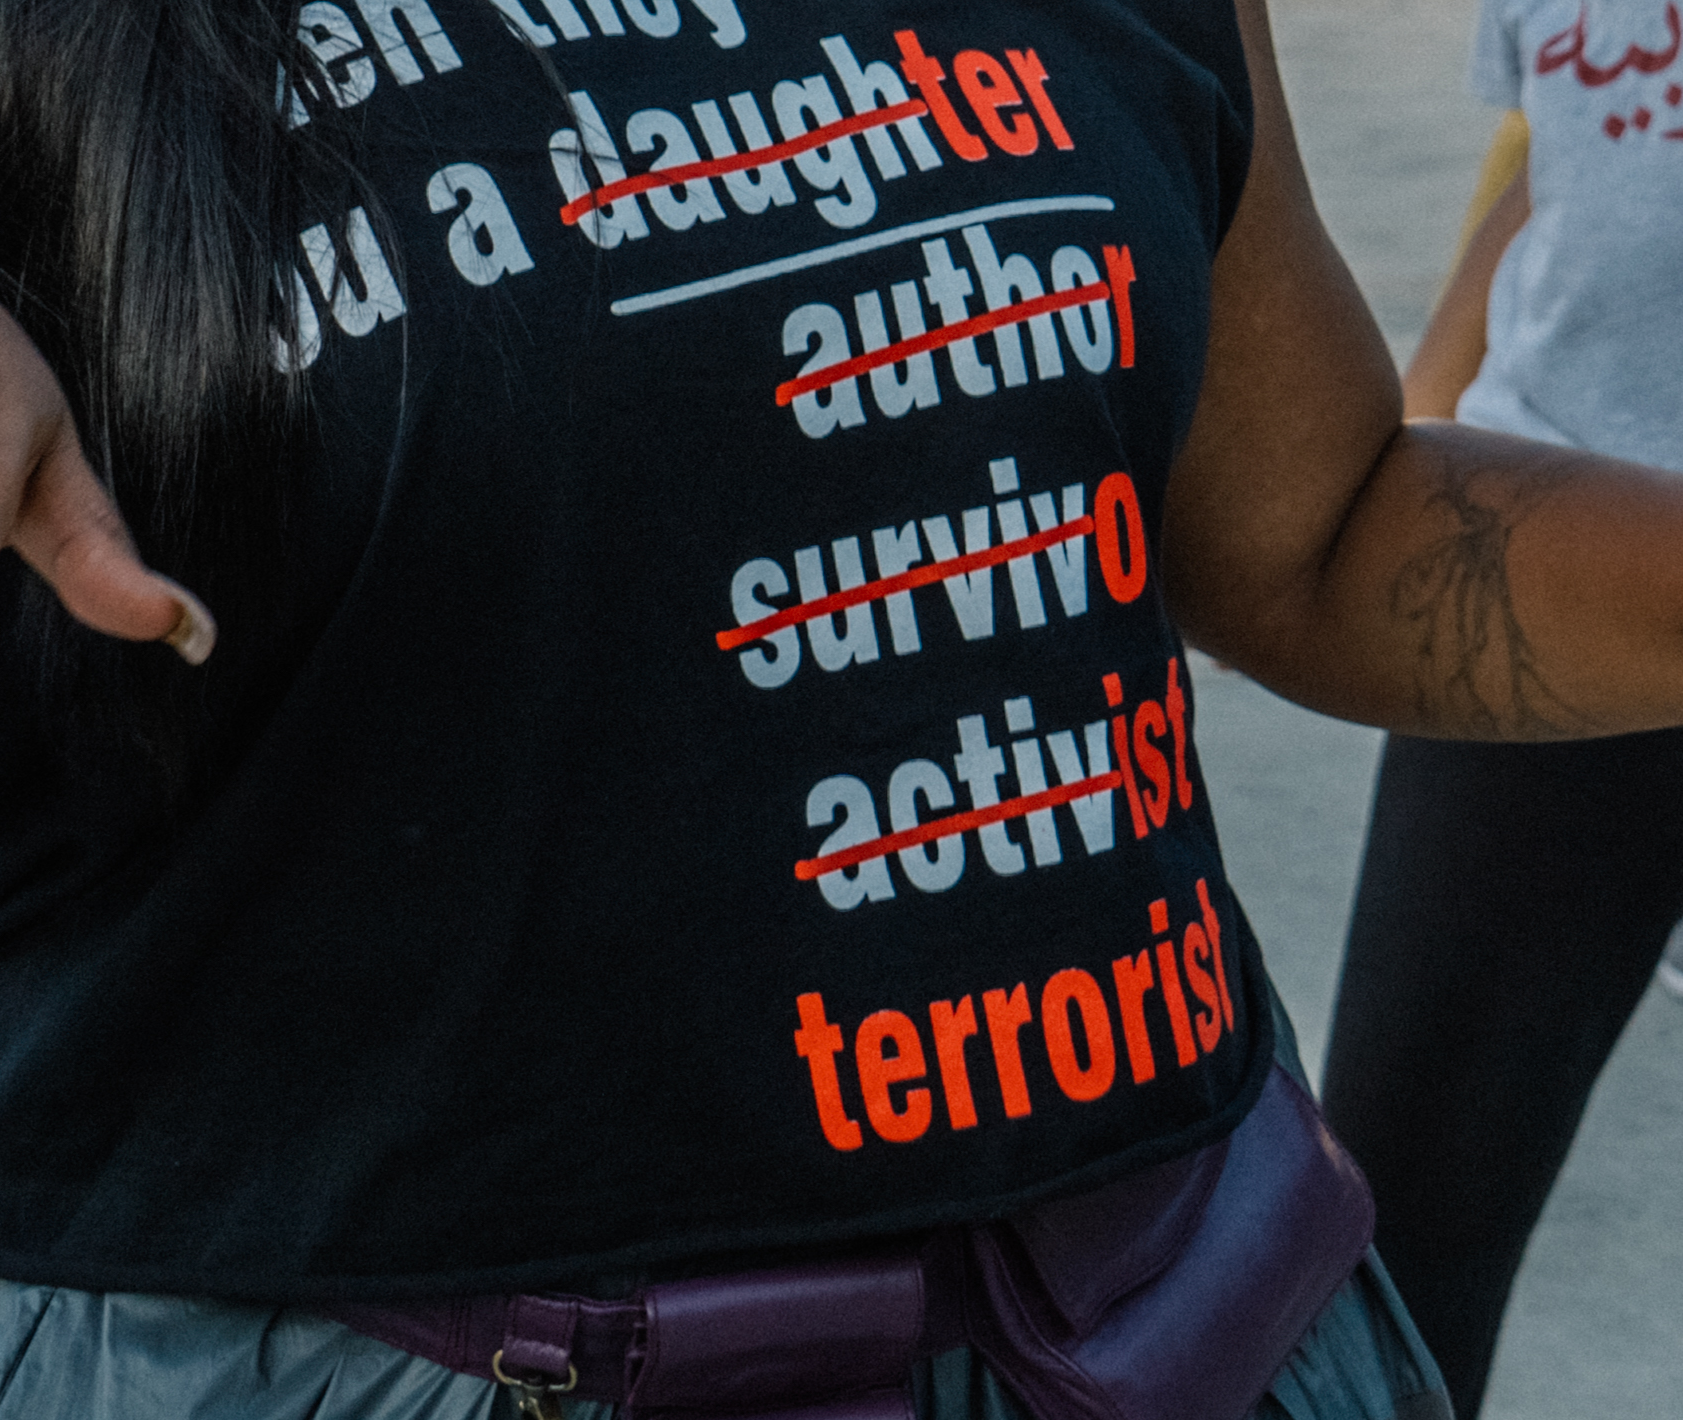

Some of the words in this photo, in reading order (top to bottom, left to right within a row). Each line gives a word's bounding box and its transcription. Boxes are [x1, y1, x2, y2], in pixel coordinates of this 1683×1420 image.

[426, 162, 536, 287] a
[548, 29, 1075, 251] daughter
[780, 224, 1136, 439] author
[804, 657, 1193, 912] activist
[793, 879, 1235, 1152] terrorist
